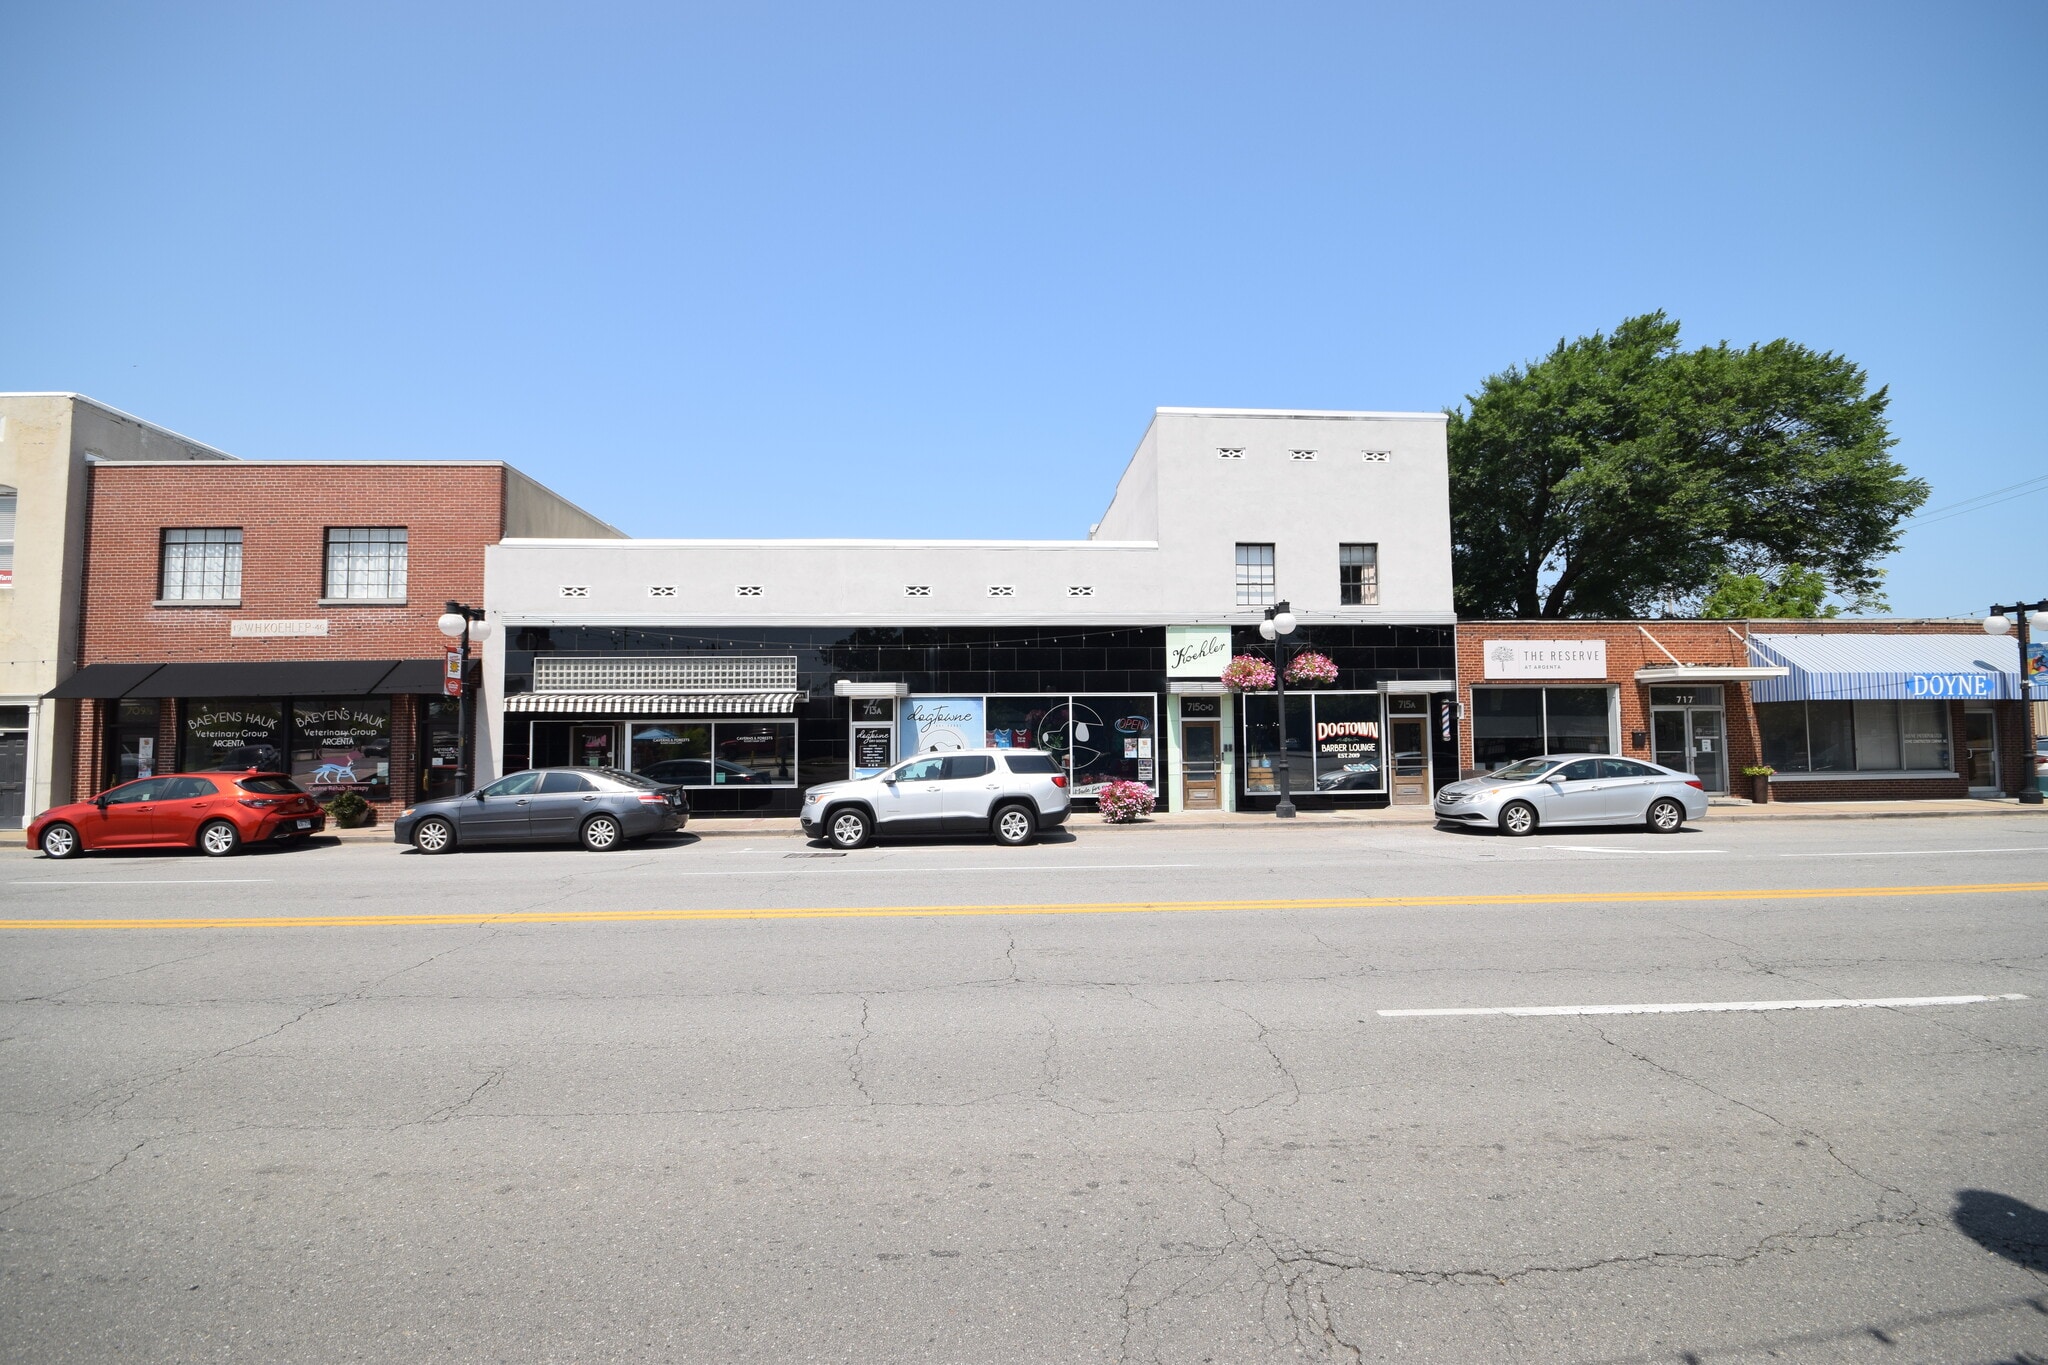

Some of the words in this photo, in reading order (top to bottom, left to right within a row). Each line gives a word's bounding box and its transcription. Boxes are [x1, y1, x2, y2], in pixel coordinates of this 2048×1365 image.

[1171, 636, 1226, 669] Koehler
[1524, 651, 1544, 661] THE
[1550, 651, 1600, 661] RESERVE
[1913, 675, 1987, 695] DOYNE
[188, 712, 242, 730] BAEYENS
[245, 713, 278, 730] HAUK
[295, 710, 350, 727] BAEYENS
[353, 712, 386, 728] HAUK
[1120, 718, 1144, 730] OPEN
[196, 730, 240, 738] Veterinary
[241, 729, 268, 738] Group
[304, 728, 349, 737] Veterinary
[350, 728, 377, 736] Group
[1317, 721, 1378, 740] DOGTOWN
[1321, 744, 1347, 752] BARBER
[1349, 743, 1376, 751] LOUNGE
